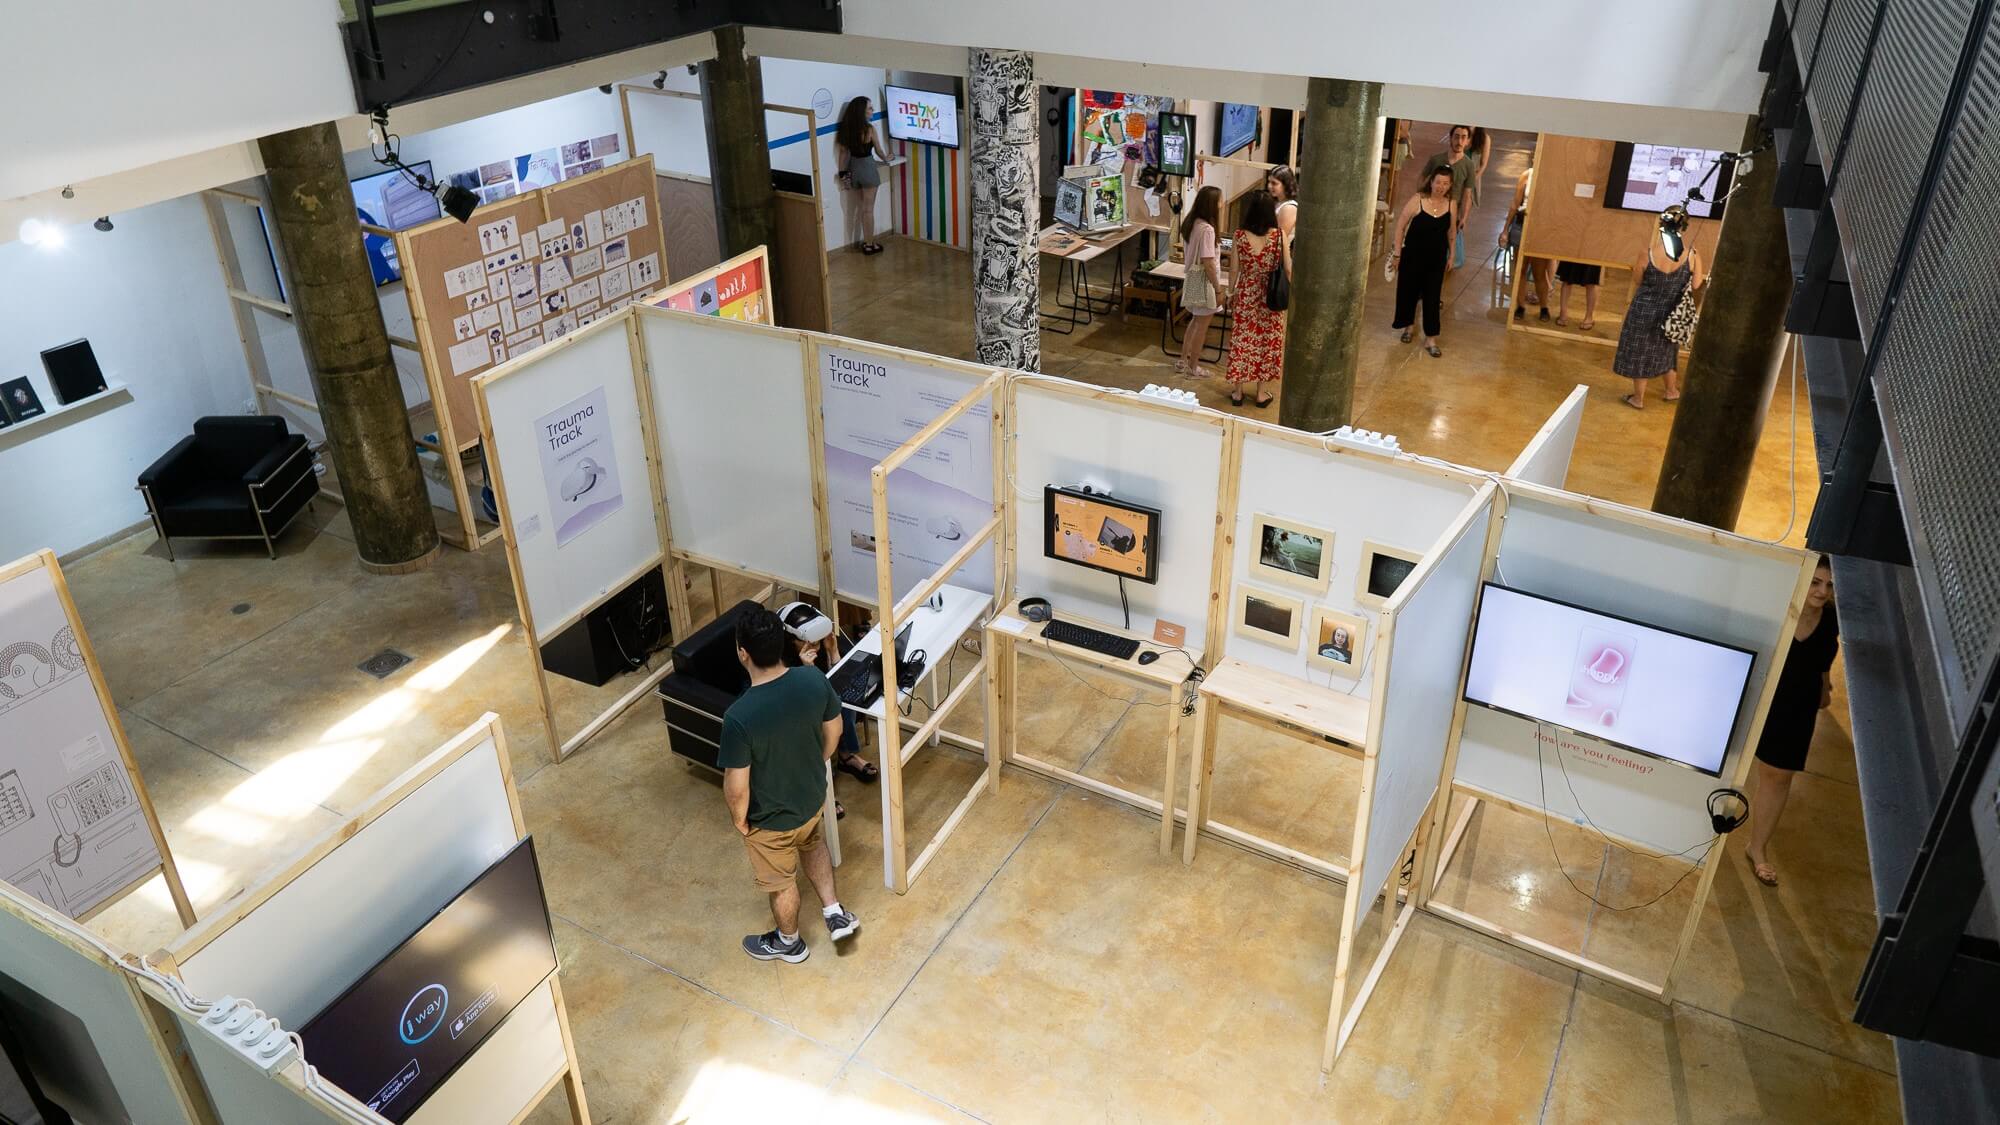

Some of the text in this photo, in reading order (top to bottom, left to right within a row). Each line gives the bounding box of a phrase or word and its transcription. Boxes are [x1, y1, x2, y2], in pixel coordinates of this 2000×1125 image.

[829, 354, 887, 378] Trauma
[829, 368, 869, 389] Track
[546, 405, 594, 437] Trauma
[549, 425, 582, 451] Track
[1560, 741, 1581, 751] are
[1583, 747, 1604, 759] you
[415, 995, 441, 1024] way
[465, 1009, 479, 1023] App
[478, 993, 496, 1012] Store
[382, 1069, 415, 1102] Google Play
